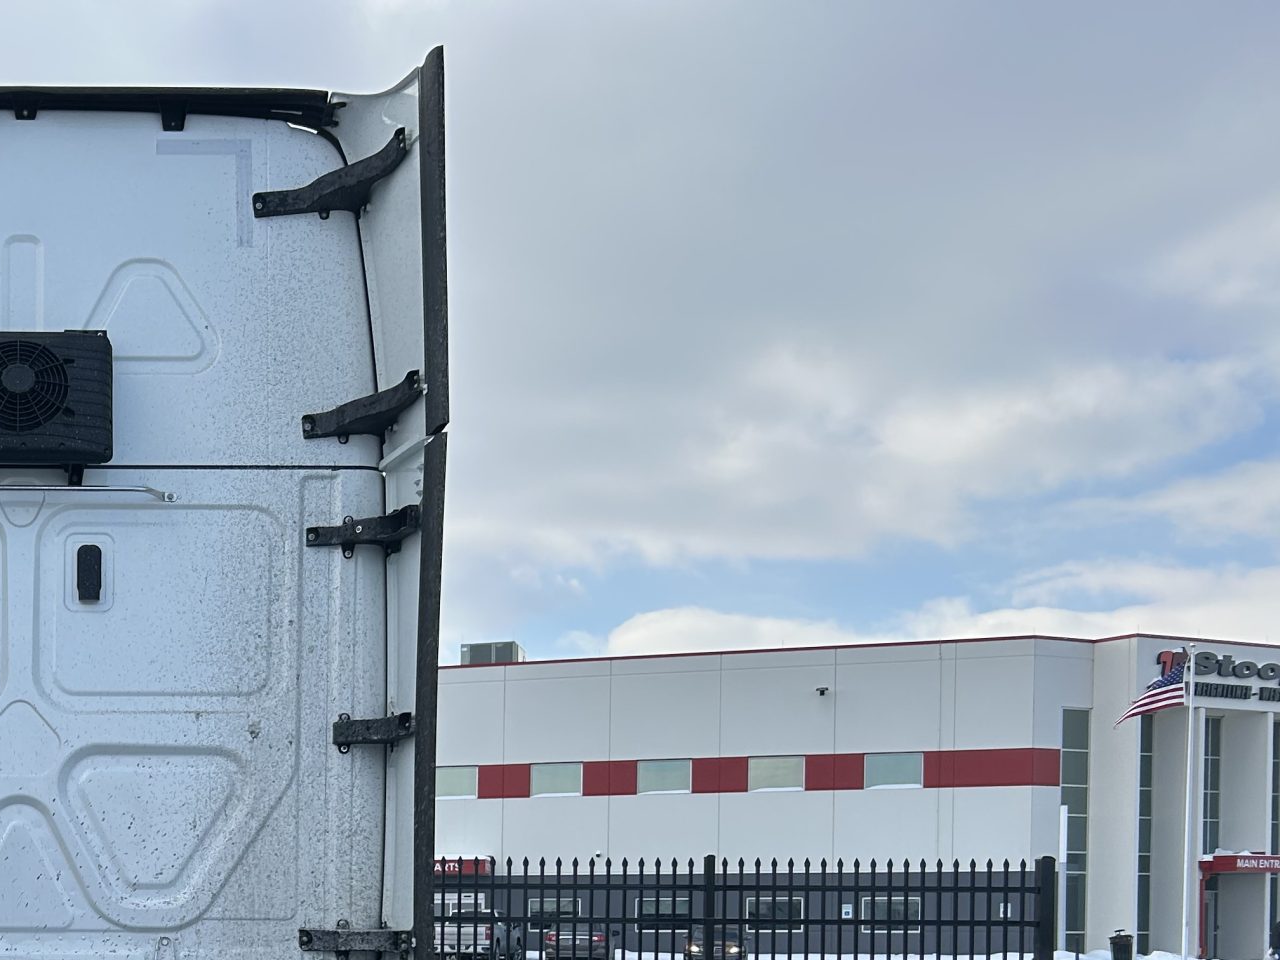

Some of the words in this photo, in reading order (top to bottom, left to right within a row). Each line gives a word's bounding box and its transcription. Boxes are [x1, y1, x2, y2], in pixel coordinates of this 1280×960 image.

[1187, 651, 1280, 686] Stoo
[434, 862, 459, 872] ARTS
[1236, 858, 1258, 868] MAIN
